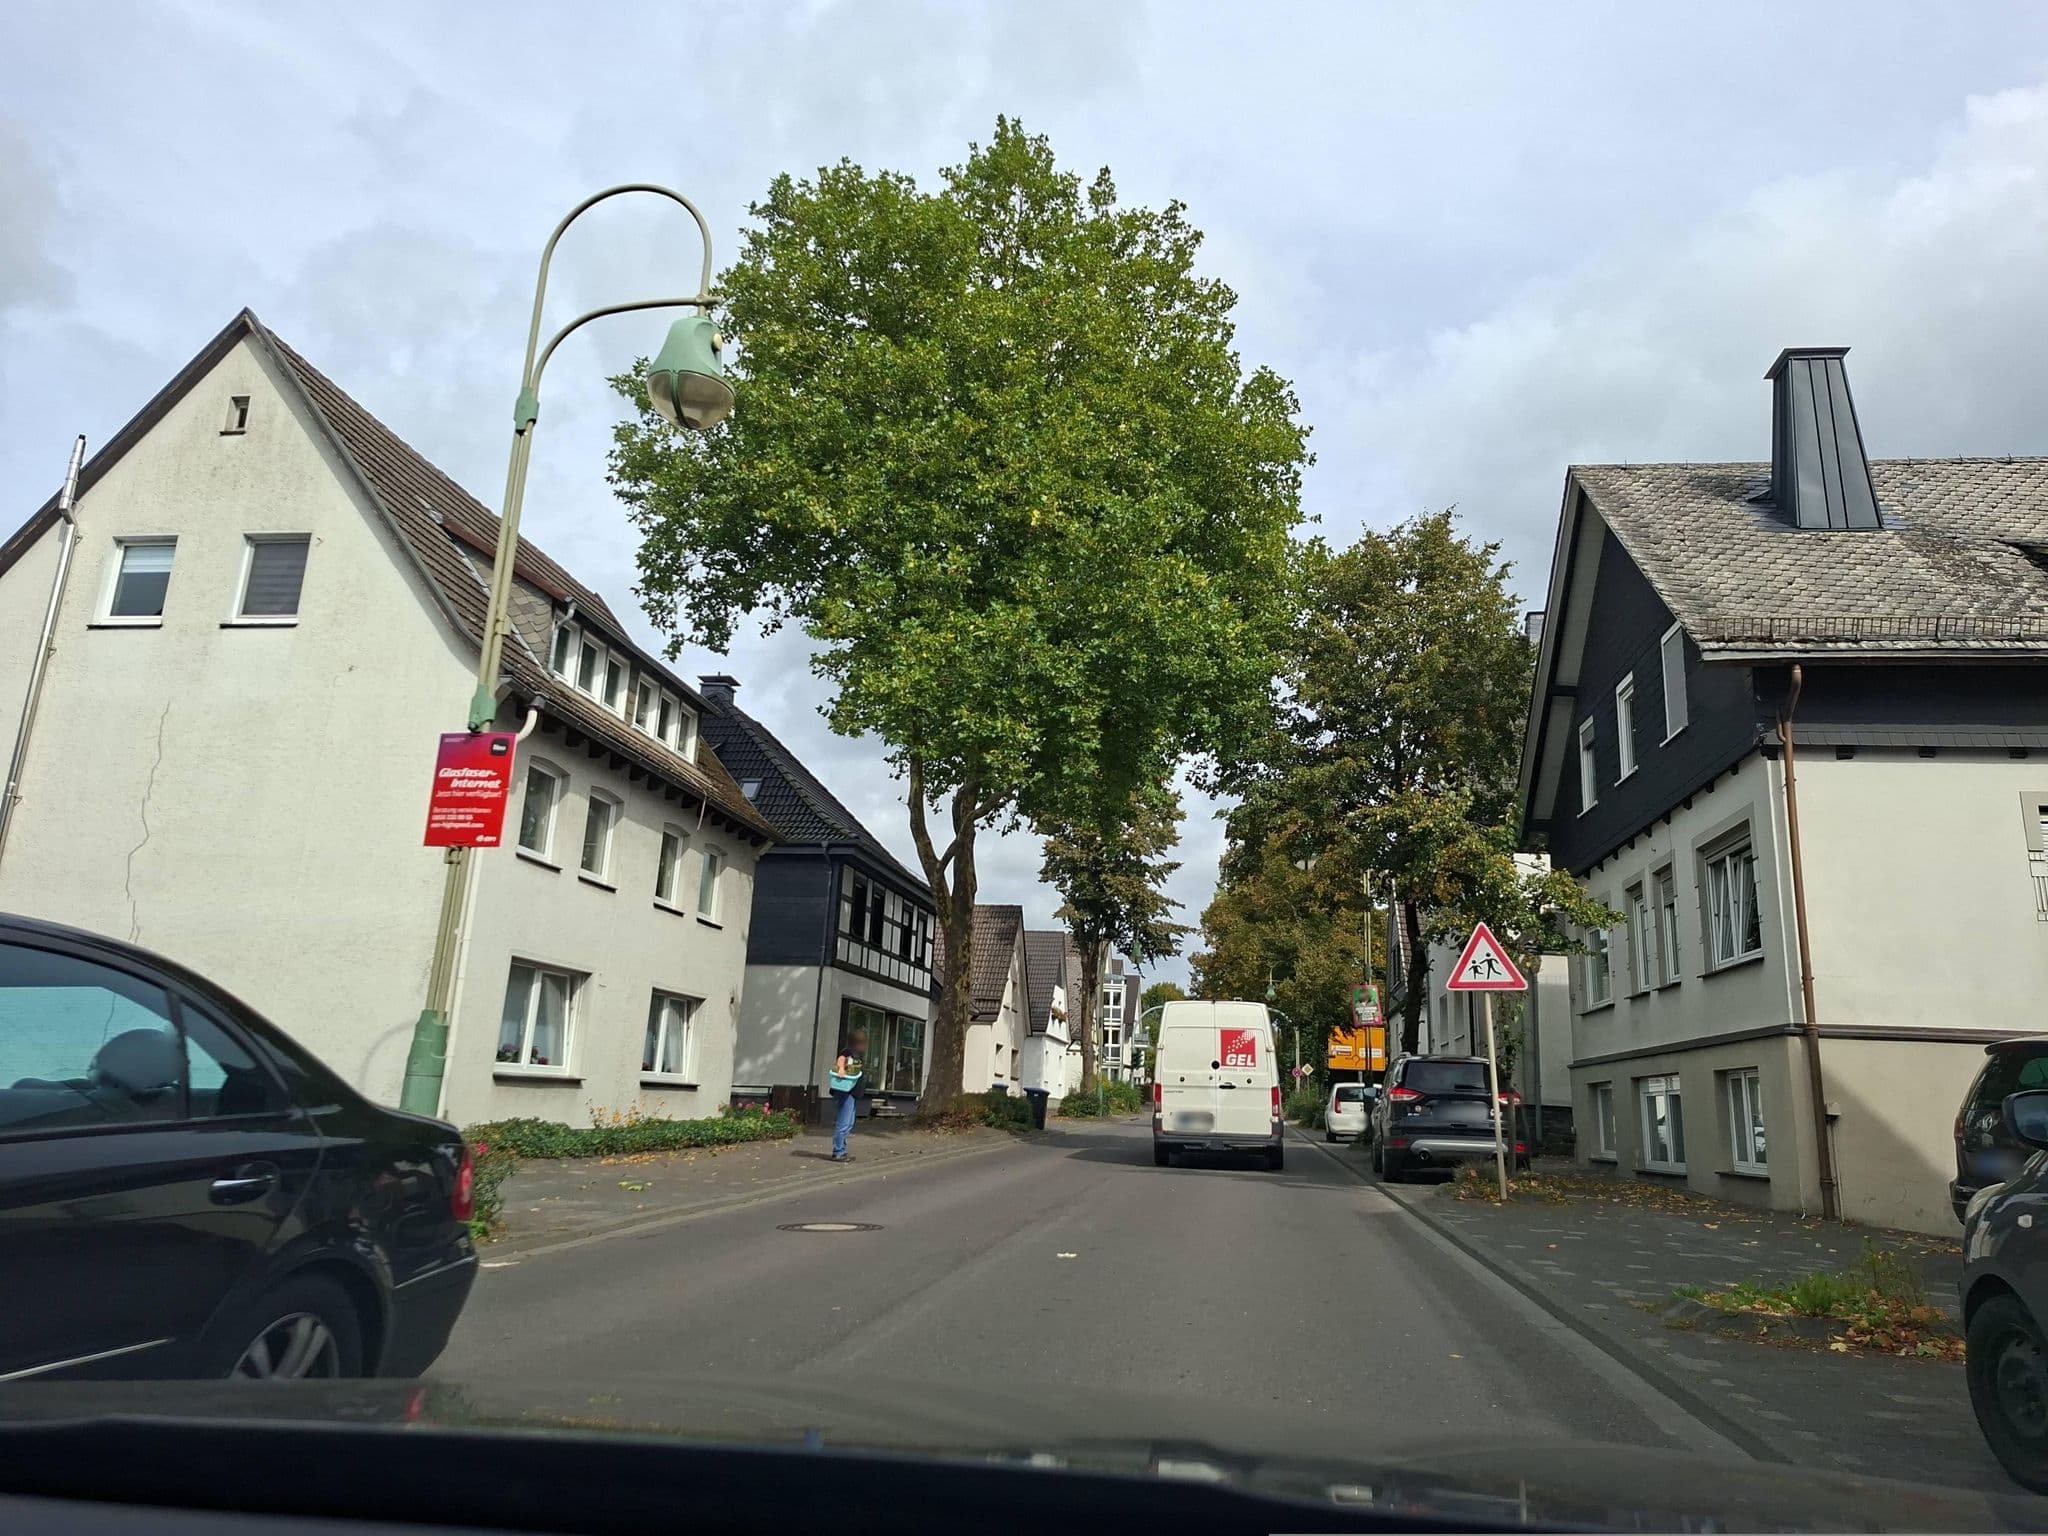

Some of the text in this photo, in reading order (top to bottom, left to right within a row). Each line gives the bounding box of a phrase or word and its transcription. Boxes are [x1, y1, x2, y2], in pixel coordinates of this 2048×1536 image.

[439, 768, 498, 777] Glasfaser-
[450, 778, 502, 788] Internet
[1226, 1053, 1255, 1066] GEL
